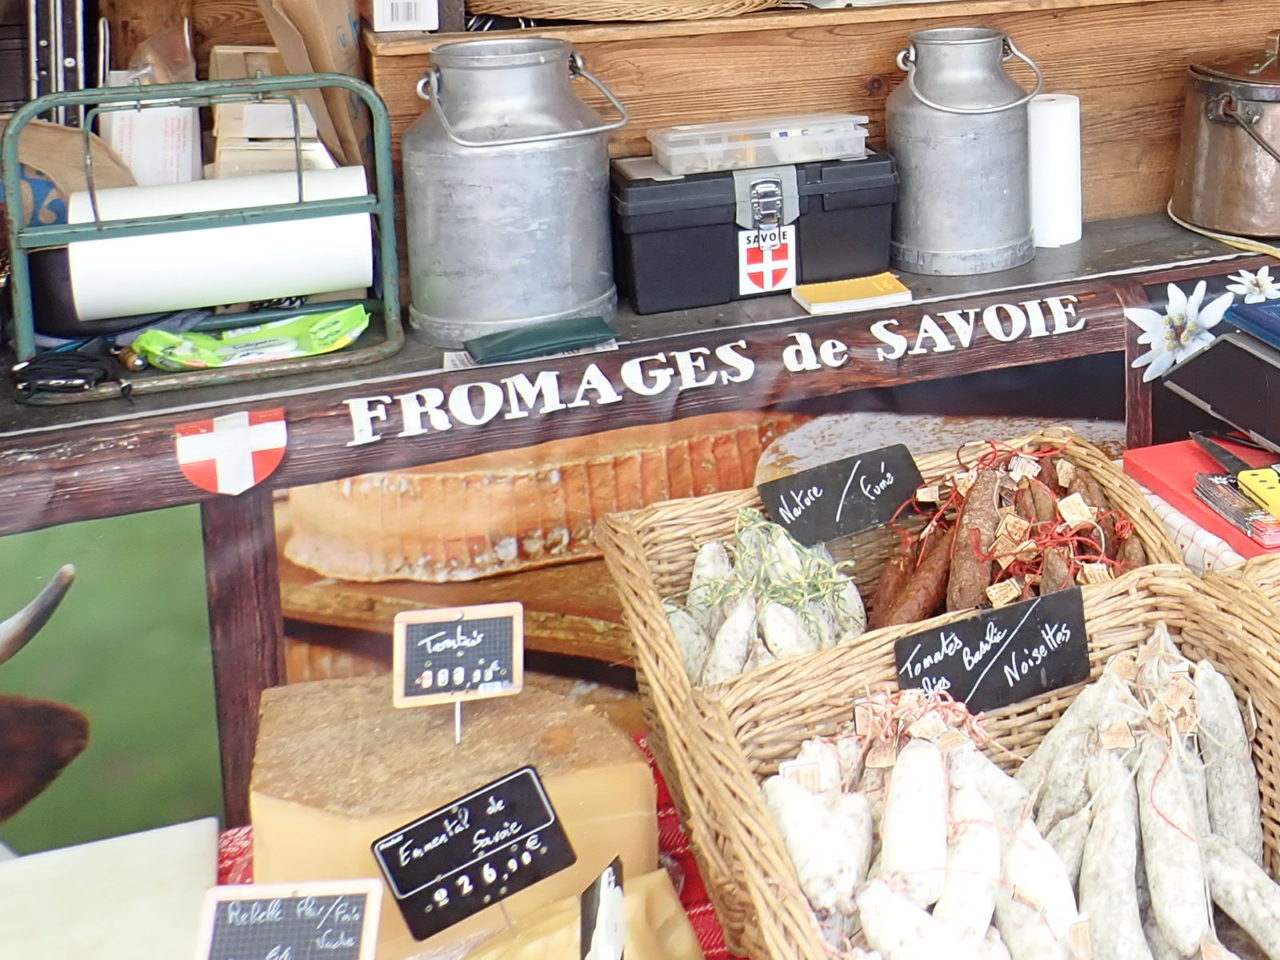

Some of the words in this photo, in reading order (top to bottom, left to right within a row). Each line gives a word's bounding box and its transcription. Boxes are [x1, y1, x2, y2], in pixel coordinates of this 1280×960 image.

[745, 230, 787, 245] SAVOE
[343, 338, 756, 448] FROMAGES
[782, 332, 849, 374] de
[870, 293, 1087, 362] SAVOIE
[899, 632, 963, 679] Tomates
[1003, 623, 1071, 687] Noisettes
[399, 807, 470, 867] Emmental
[486, 795, 505, 816] de
[472, 821, 523, 853] Savoie
